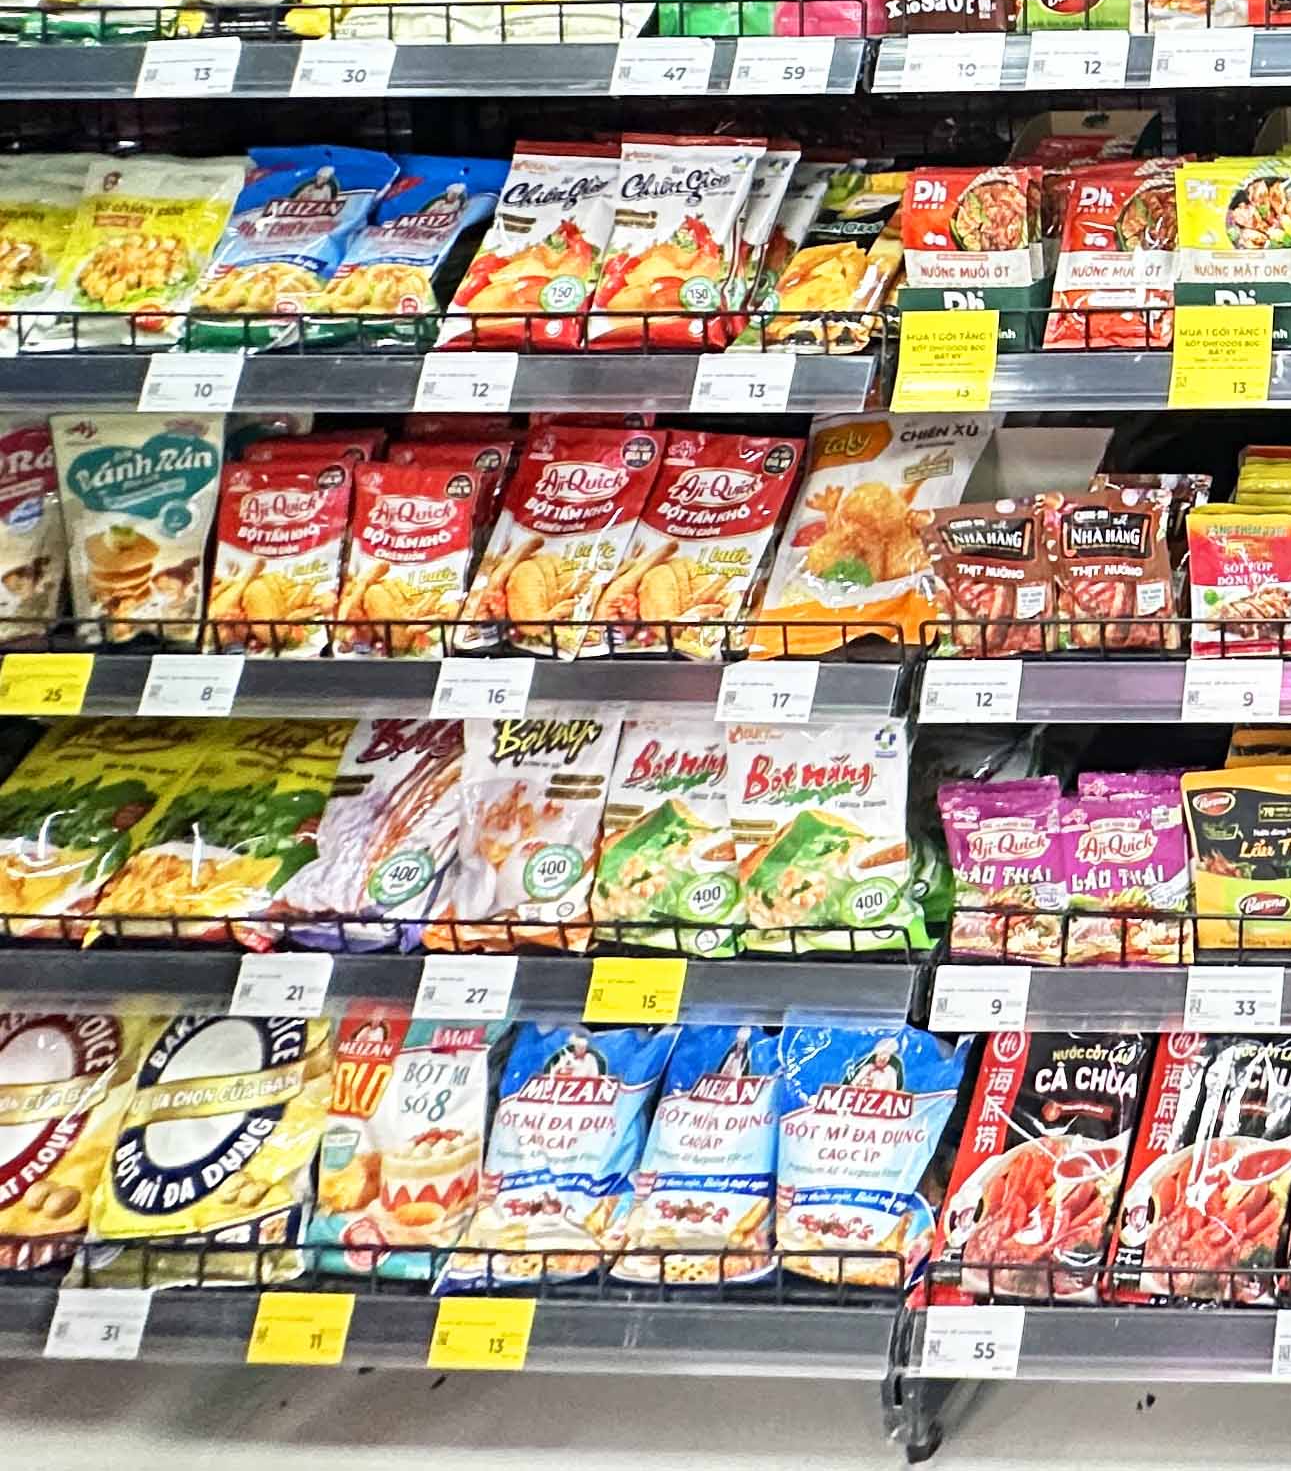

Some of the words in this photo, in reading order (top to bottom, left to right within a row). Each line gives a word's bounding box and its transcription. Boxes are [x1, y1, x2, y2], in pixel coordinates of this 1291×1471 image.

[343, 69, 367, 83] 30
[663, 67, 687, 80] 47
[783, 66, 805, 80] 59
[195, 383, 213, 398] 10
[749, 384, 766, 398] 13
[773, 693, 790, 708] 17
[1243, 692, 1254, 707] 9
[388, 866, 418, 881] 400
[537, 860, 566, 875] 400
[465, 988, 488, 1003] 27
[642, 995, 656, 1009] 15
[992, 999, 1002, 1015] 9
[1234, 1000, 1256, 1016] 33
[818, 1093, 911, 1117] MEIZAN
[101, 1325, 120, 1341] 31
[973, 1342, 995, 1359] 55
